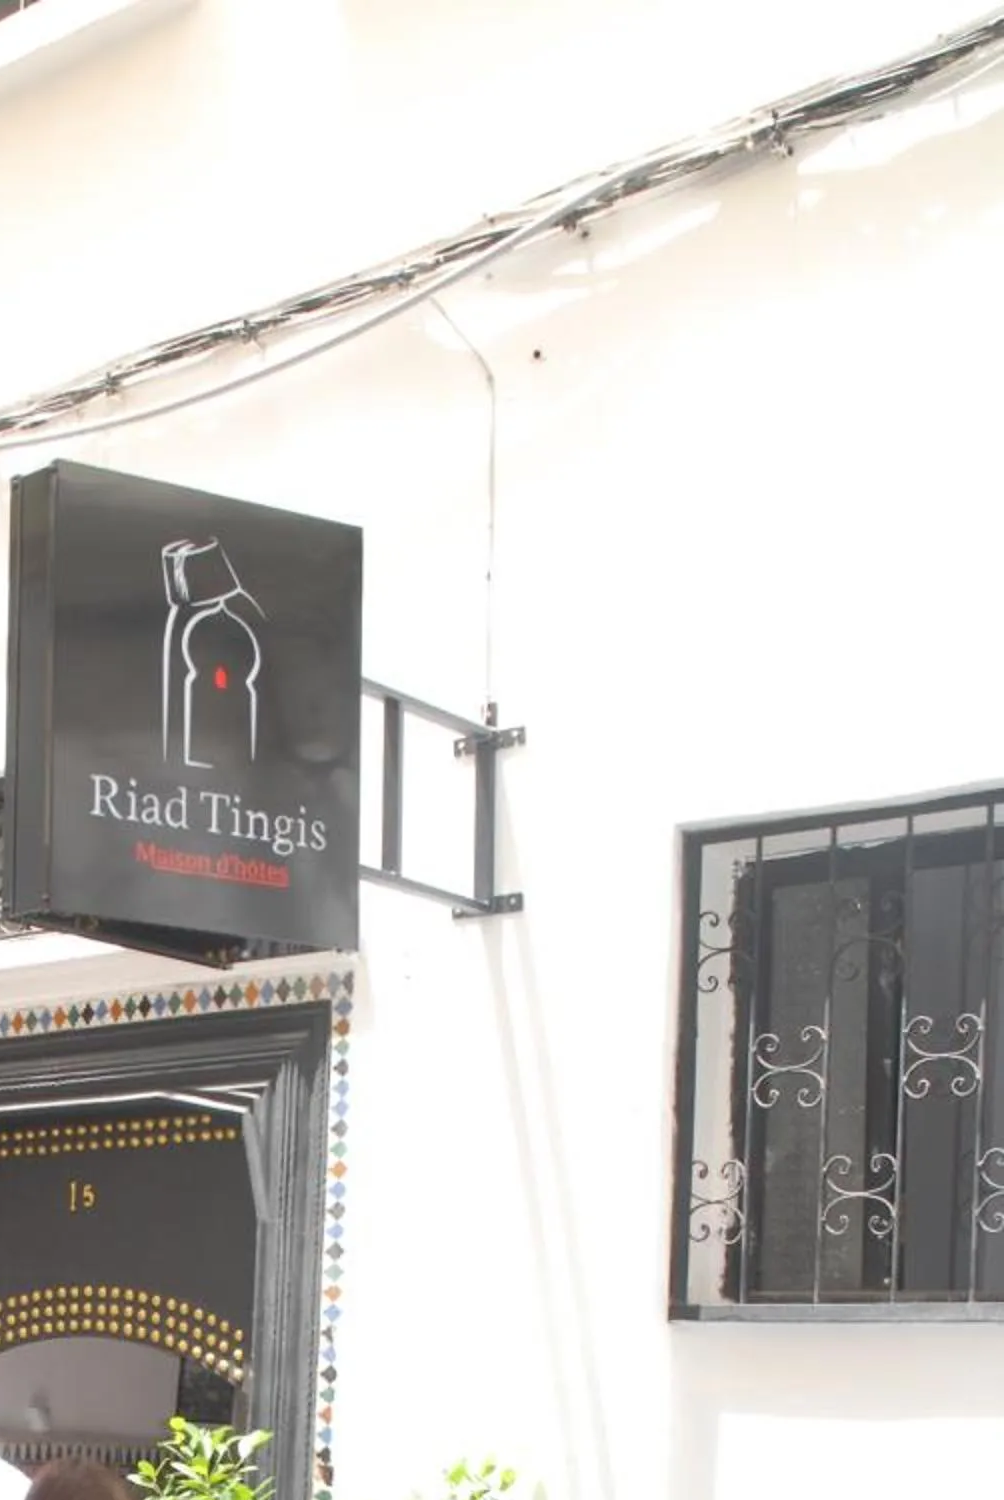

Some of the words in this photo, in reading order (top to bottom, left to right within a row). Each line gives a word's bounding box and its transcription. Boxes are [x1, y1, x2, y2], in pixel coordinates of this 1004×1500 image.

[90, 773, 190, 831] Riad
[199, 790, 327, 856] Tingis
[134, 841, 212, 875] Maison
[70, 1181, 95, 1212] 15
